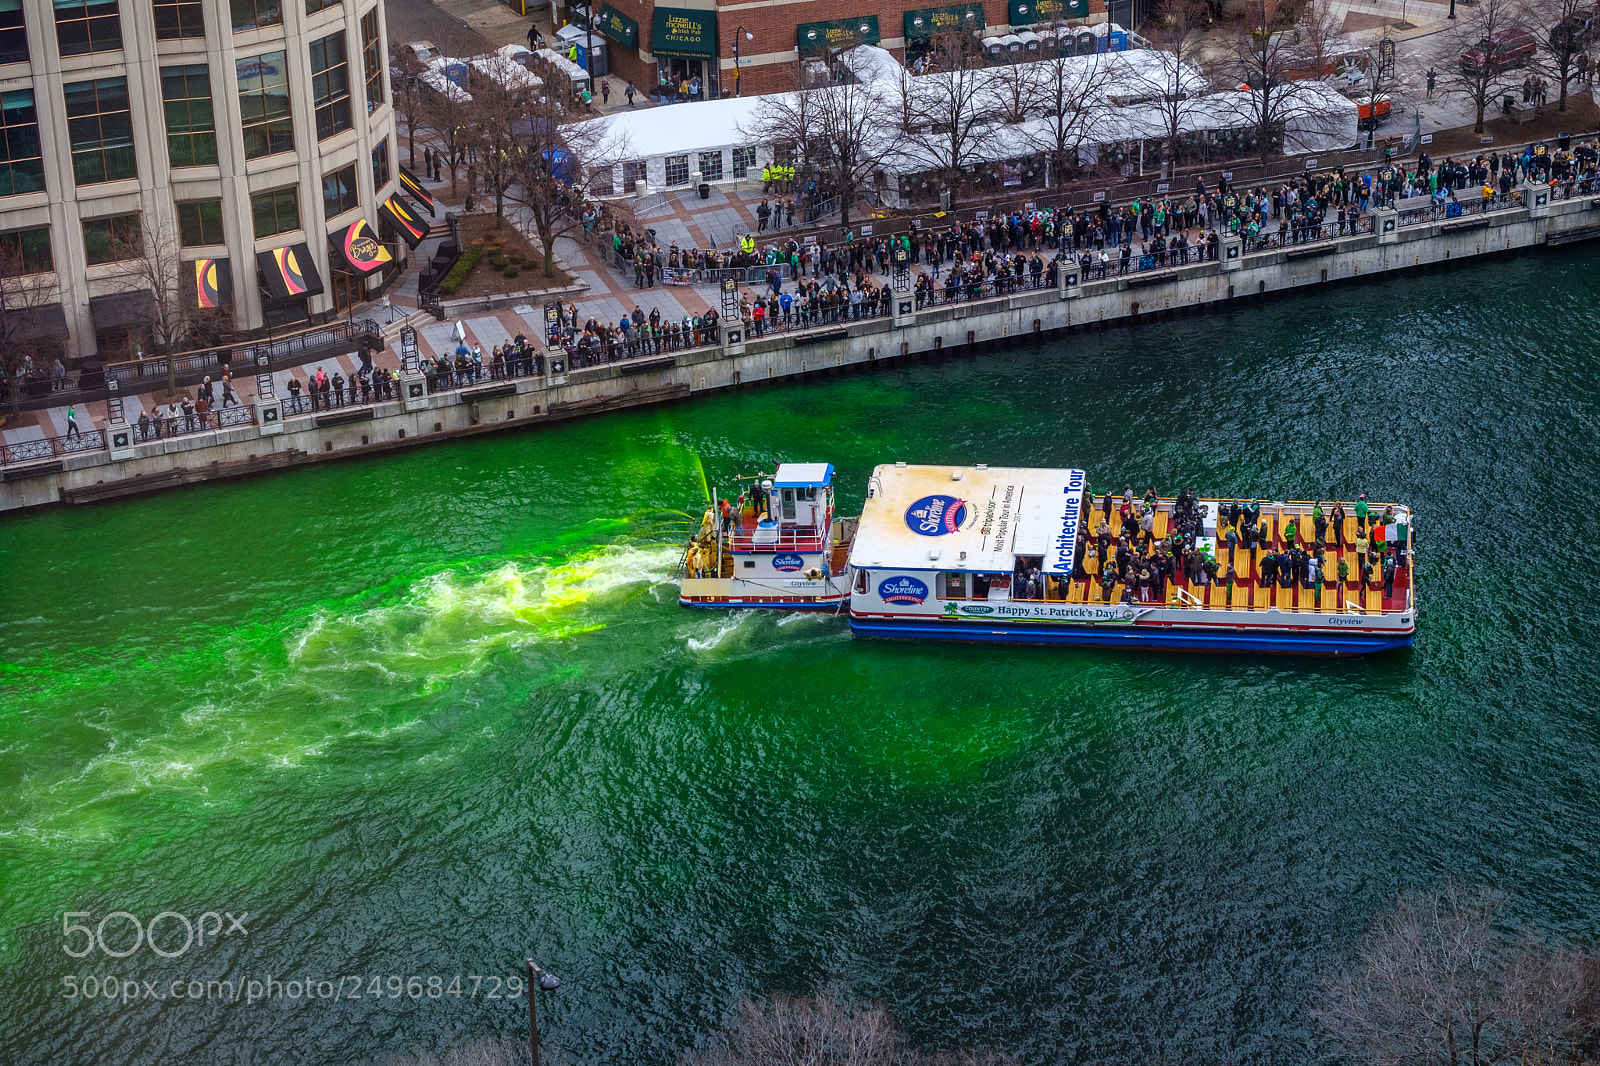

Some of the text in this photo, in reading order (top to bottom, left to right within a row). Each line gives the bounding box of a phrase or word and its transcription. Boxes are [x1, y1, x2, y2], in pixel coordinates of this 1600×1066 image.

[1002, 485, 1014, 504] America
[920, 498, 945, 533] Shoreline
[983, 500, 996, 526] tripadvisor
[999, 508, 1010, 520] Tour
[1053, 470, 1084, 572] Architecture Tour
[996, 520, 1008, 539] Popular
[994, 540, 1004, 552] Most
[883, 584, 924, 594] Shoreline
[998, 606, 1118, 620] Happy St. Patrick's Day!
[1328, 617, 1363, 625] Cityview
